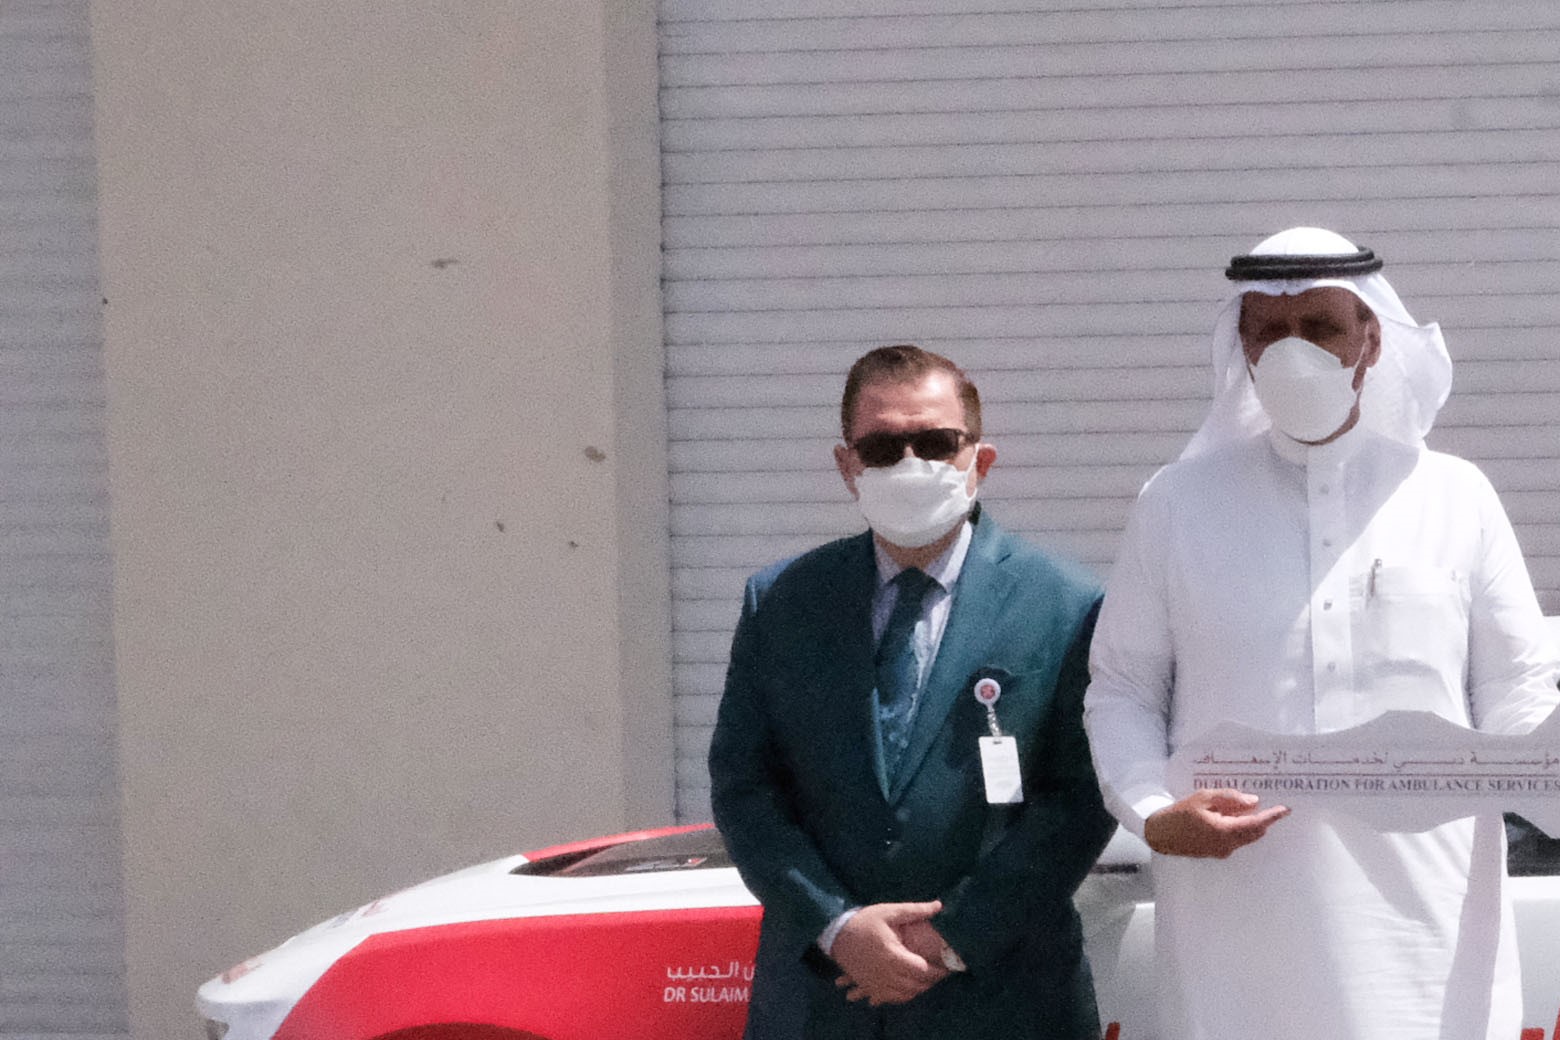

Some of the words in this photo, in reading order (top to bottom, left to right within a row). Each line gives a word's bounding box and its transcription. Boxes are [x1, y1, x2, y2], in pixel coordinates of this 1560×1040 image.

[1193, 778, 1238, 790] DUBAI
[1242, 778, 1350, 791] CORPORATION
[1354, 779, 1385, 791] FOR
[1389, 779, 1482, 791] AMBULANCE
[664, 986, 686, 1002] DR
[690, 986, 750, 1002] SULAIM
